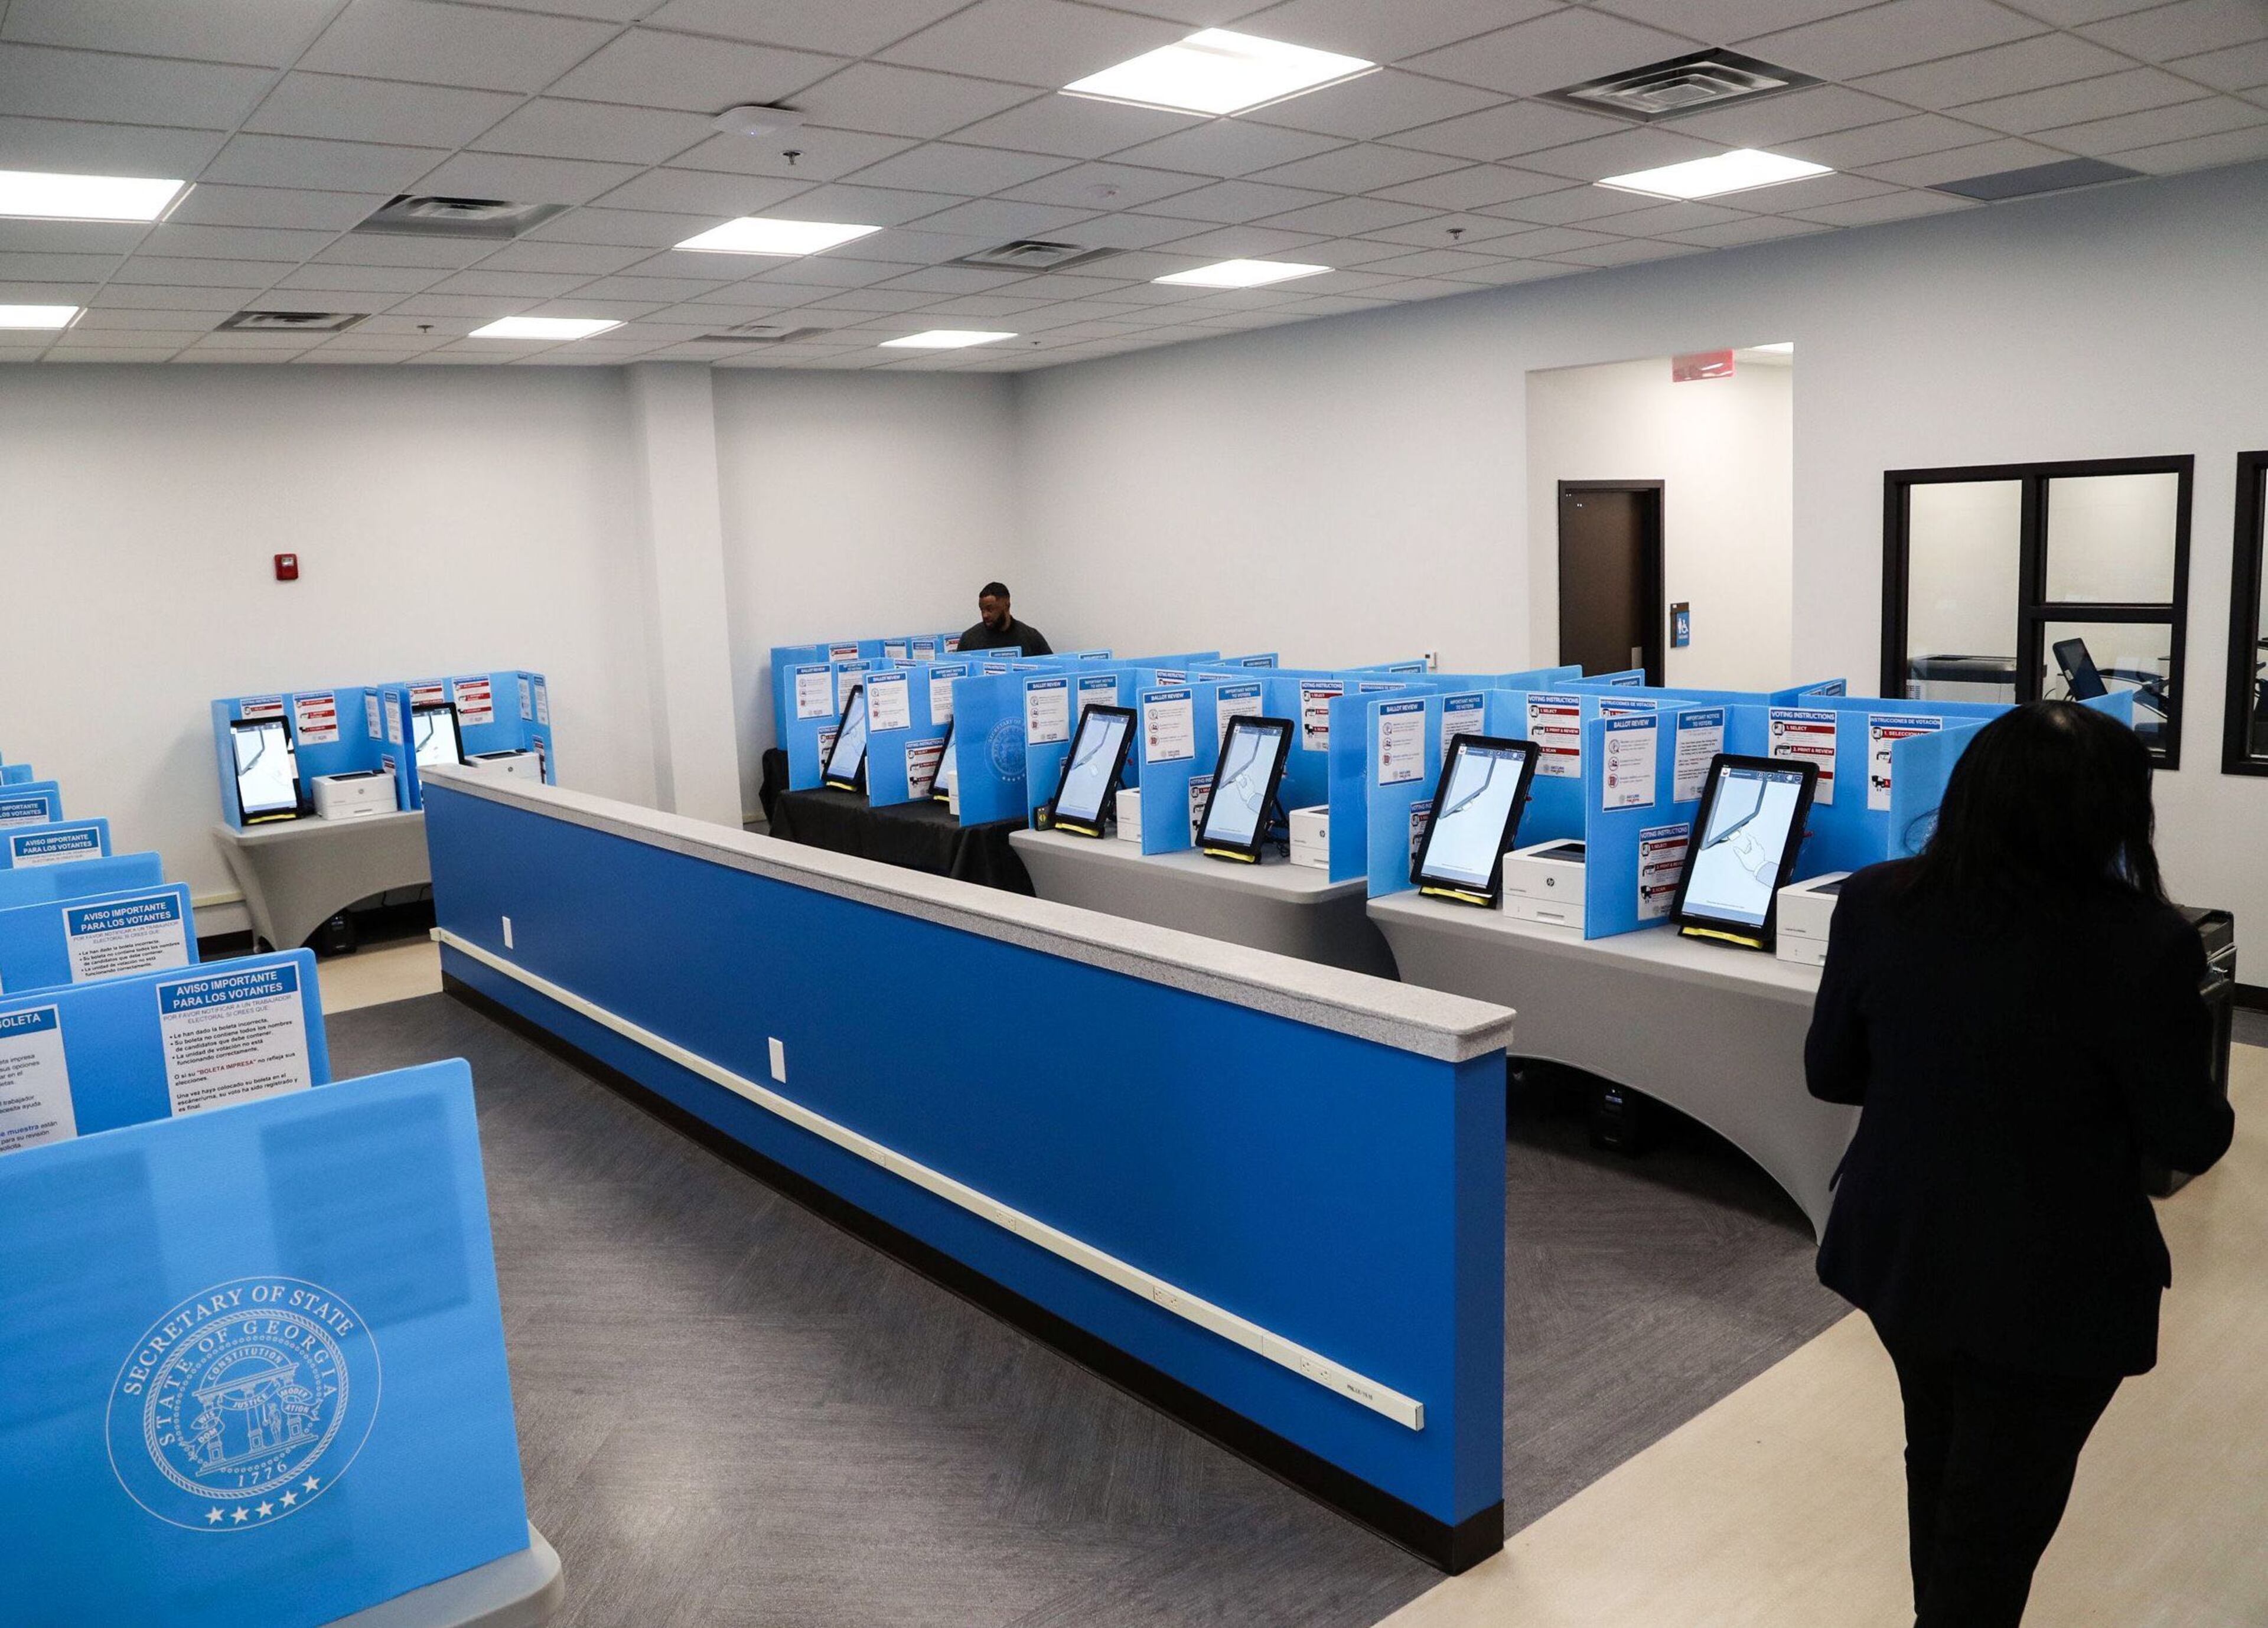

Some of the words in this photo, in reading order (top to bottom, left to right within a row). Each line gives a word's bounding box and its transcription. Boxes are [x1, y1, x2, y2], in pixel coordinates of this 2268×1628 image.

[1546, 696, 1579, 704] INSTRUCTIONS
[1794, 712, 1834, 720] INSTRUCTIONS
[25, 838, 45, 846] AVISO
[47, 834, 89, 843] IMPORTANTE
[1657, 827, 1687, 837] INSTRUCTIONS
[23, 846, 42, 854] PARA
[57, 841, 92, 850] VOTANTES
[83, 912, 110, 921] AVISO
[112, 902, 166, 917] IMPORTANTE
[81, 922, 105, 931] PARA
[107, 918, 124, 928] LOS
[126, 911, 171, 925] VOTANTES
[177, 983, 208, 996] AVISO
[211, 971, 278, 990] IMPORTANTE
[173, 996, 203, 1009] PARA
[206, 992, 226, 1003] LOS
[229, 983, 283, 999] VOTANTES
[213, 1030, 238, 1039] contiene
[268, 1020, 292, 1029] nombres
[184, 1041, 217, 1051] candidatos
[177, 1055, 214, 1065] funcionando
[217, 1082, 244, 1091] colocado
[7, 1124, 39, 1136] muestra
[123, 1287, 242, 1397] SECRETARY
[252, 1286, 285, 1303] OF
[289, 1289, 354, 1338] STATE
[207, 1348, 284, 1381] CONSTITUTION
[157, 1359, 193, 1447] STATE
[198, 1328, 228, 1353] OF
[243, 1320, 338, 1398] GEORGIA
[233, 1392, 269, 1408] JUSTICE
[237, 1461, 288, 1487] 1776
